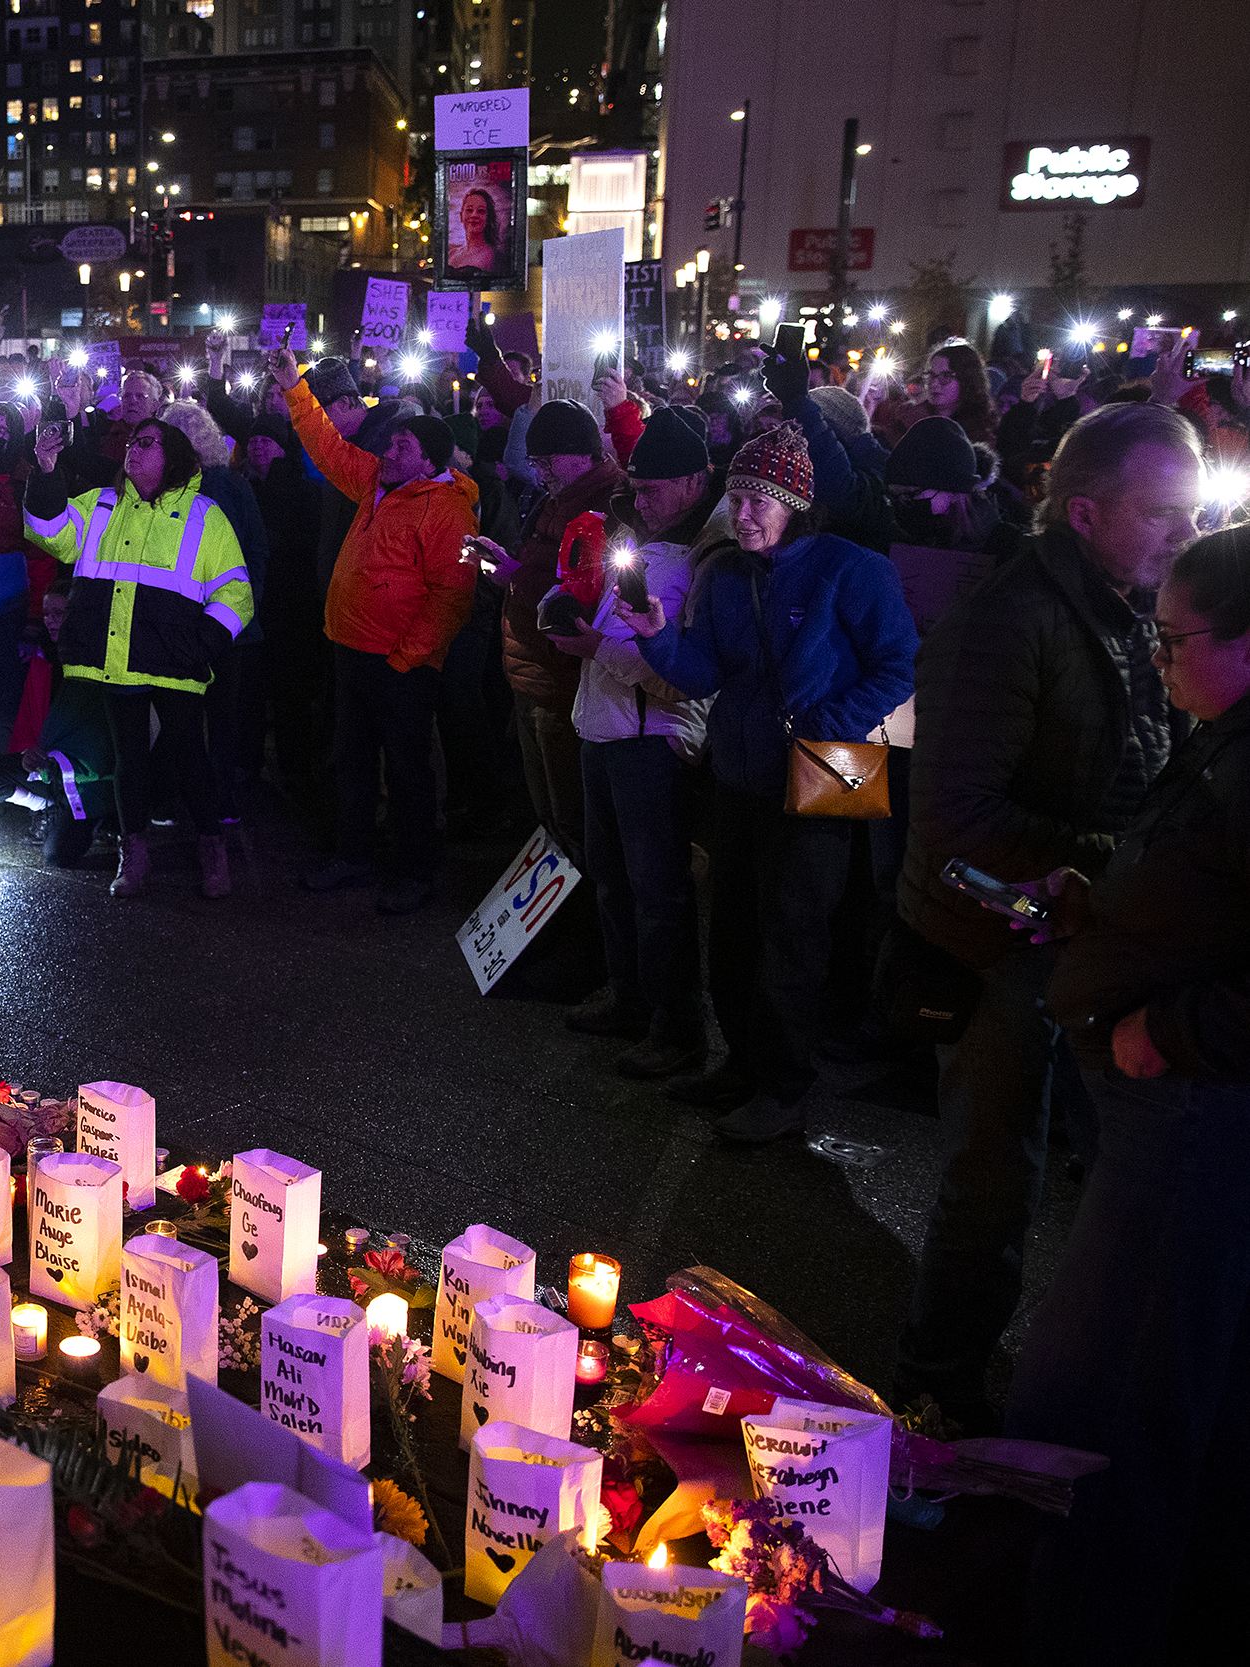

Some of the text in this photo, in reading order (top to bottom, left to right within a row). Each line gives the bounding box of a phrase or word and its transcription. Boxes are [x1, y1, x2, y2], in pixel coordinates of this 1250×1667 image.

[451, 97, 511, 112] MURDERED
[463, 129, 501, 145] ICE
[1028, 145, 1130, 174] Public
[1010, 173, 1140, 204] Storage
[804, 234, 861, 249] Pubc
[369, 283, 405, 300] SHE
[367, 301, 399, 319] WAS
[361, 323, 400, 344] GOOD
[504, 837, 565, 933] USA
[36, 1187, 82, 1224] Marie
[242, 1212, 258, 1237] Ge
[35, 1240, 80, 1272] Blaise
[444, 1264, 470, 1296] Kai
[446, 1292, 470, 1325] Yin
[126, 1321, 168, 1355] Uribe
[277, 1359, 302, 1384] Ali
[470, 1368, 490, 1399] Xie
[210, 1539, 286, 1609] Jesus
